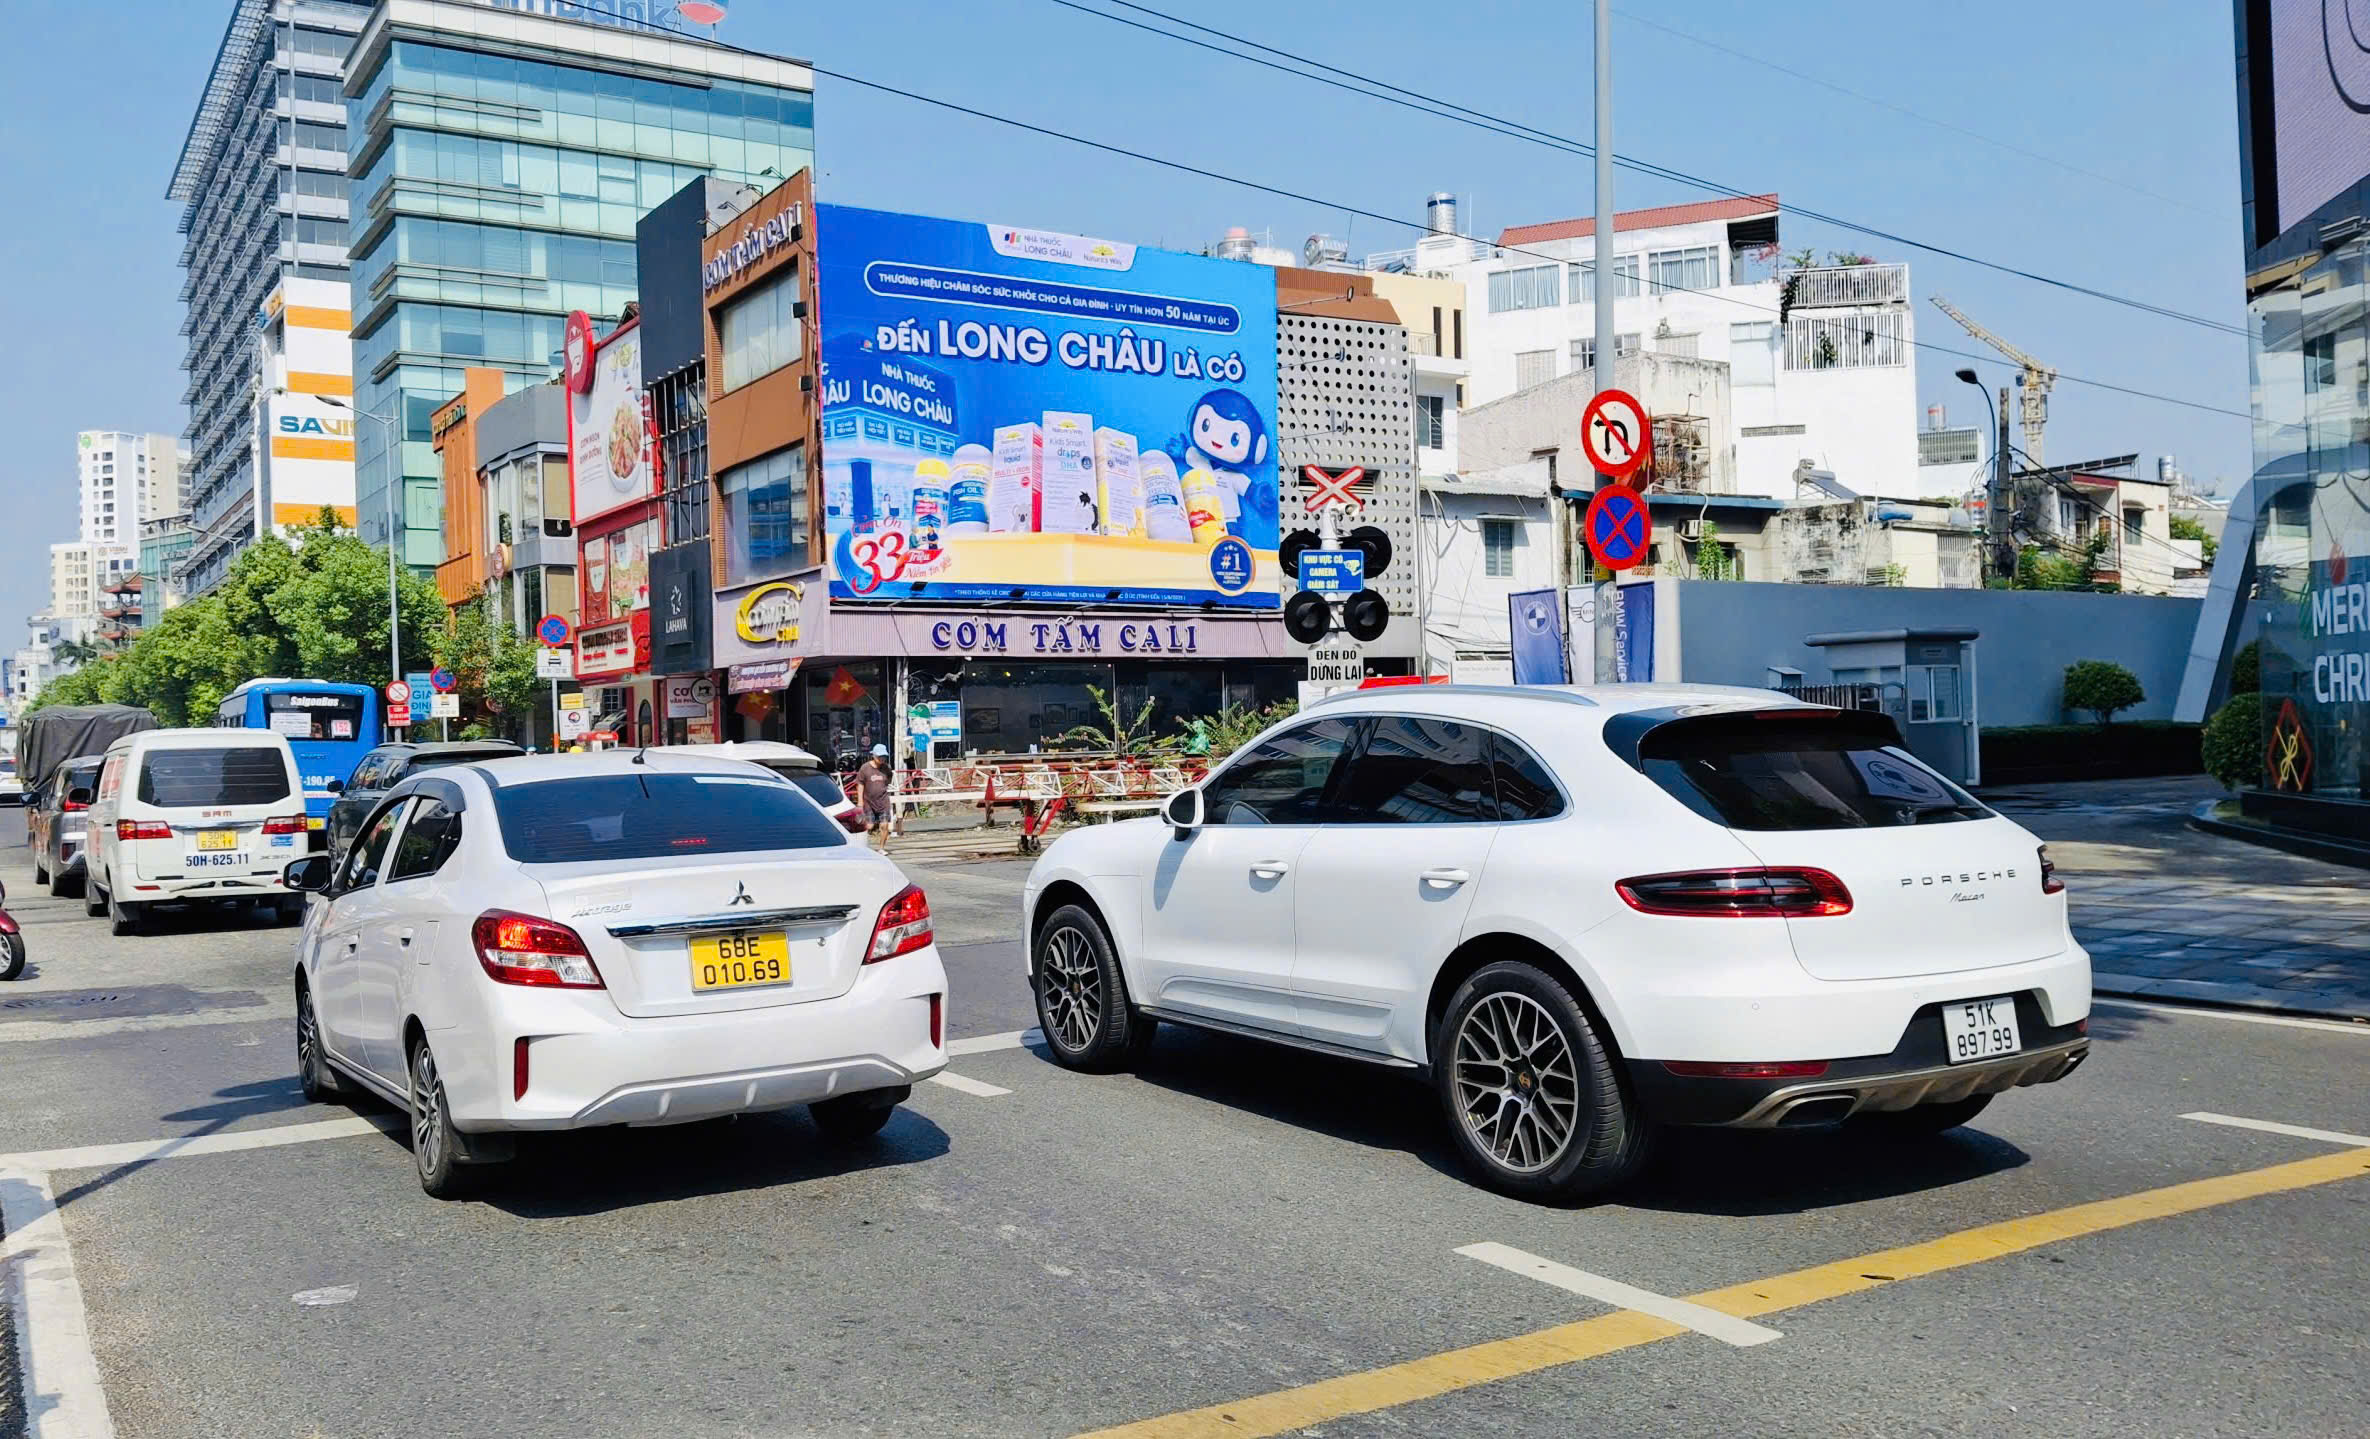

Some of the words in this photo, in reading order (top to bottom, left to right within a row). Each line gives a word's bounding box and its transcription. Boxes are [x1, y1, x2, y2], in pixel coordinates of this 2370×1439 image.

[1024, 244, 1049, 256] LONG
[1049, 247, 1073, 259] CHÂU
[878, 273, 919, 286] THƯƠNG
[920, 278, 942, 290] HIỆU
[942, 280, 971, 293] CHĂM
[971, 284, 992, 296] SÓC
[992, 286, 1012, 299] SỨC
[1012, 288, 1037, 302] KHỎE
[1037, 294, 1058, 305] CHO
[1058, 293, 1071, 306] CẢ
[1072, 297, 1088, 307] GIA
[1115, 304, 1127, 313] UY
[1128, 303, 1143, 315] TÍN
[1144, 306, 1164, 317] HƠN
[1165, 305, 1181, 320] 50
[1182, 310, 1201, 322] NĂM
[1203, 315, 1217, 326] TẠI
[1217, 313, 1230, 327] ÚC
[877, 317, 930, 354] ĐẾN
[938, 319, 1048, 364] LONG
[1057, 329, 1164, 374] CHÂU
[1172, 341, 1203, 378] LÀ
[1206, 350, 1244, 382] CÓ
[881, 362, 904, 382] NHÀ
[904, 370, 936, 392] THUỐC
[863, 380, 911, 413] LONG
[914, 397, 952, 425] CHÂU
[852, 532, 904, 594] 33
[1221, 553, 1242, 571] #1
[1309, 568, 1337, 576] CAMERA
[1326, 579, 1340, 589] SÁT
[1615, 590, 1626, 628] BMW
[2312, 582, 2370, 637] MER
[665, 617, 688, 634] LAHAVA
[932, 616, 1007, 649] CƠM
[1030, 616, 1101, 650] TẤM
[1120, 624, 1197, 650] CALI
[1616, 632, 1630, 681] Service
[290, 696, 339, 707] SaigonBus
[335, 722, 348, 732] 152
[201, 840, 232, 848] 625.11
[185, 853, 249, 867] 50H-625.11
[1900, 869, 2017, 888] PORSCHE
[1950, 892, 1985, 903] Macan
[571, 903, 632, 919] Attrage
[718, 936, 761, 959] 68E
[703, 959, 780, 985] 010.69
[1964, 1002, 1997, 1029] 51K
[1957, 1027, 2013, 1057] 897.99
